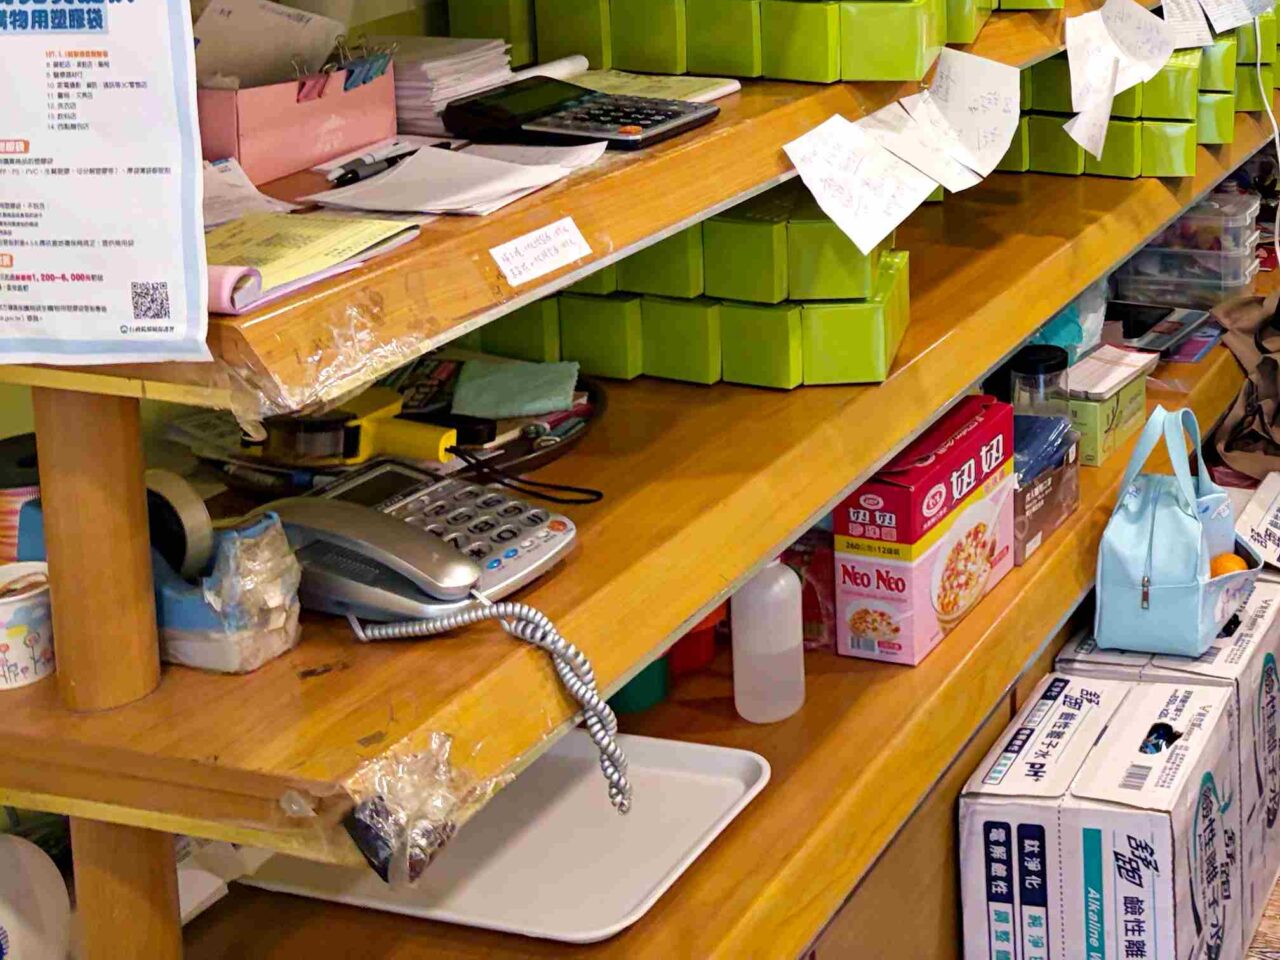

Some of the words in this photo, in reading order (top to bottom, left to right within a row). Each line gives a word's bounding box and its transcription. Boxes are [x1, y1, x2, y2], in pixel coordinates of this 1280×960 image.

[988, 827, 1009, 896] 電解鹼性
[1024, 838, 1043, 889] 鈦淨化
[1113, 834, 1159, 888] 舒跑
[1086, 886, 1104, 948] Alkaline
